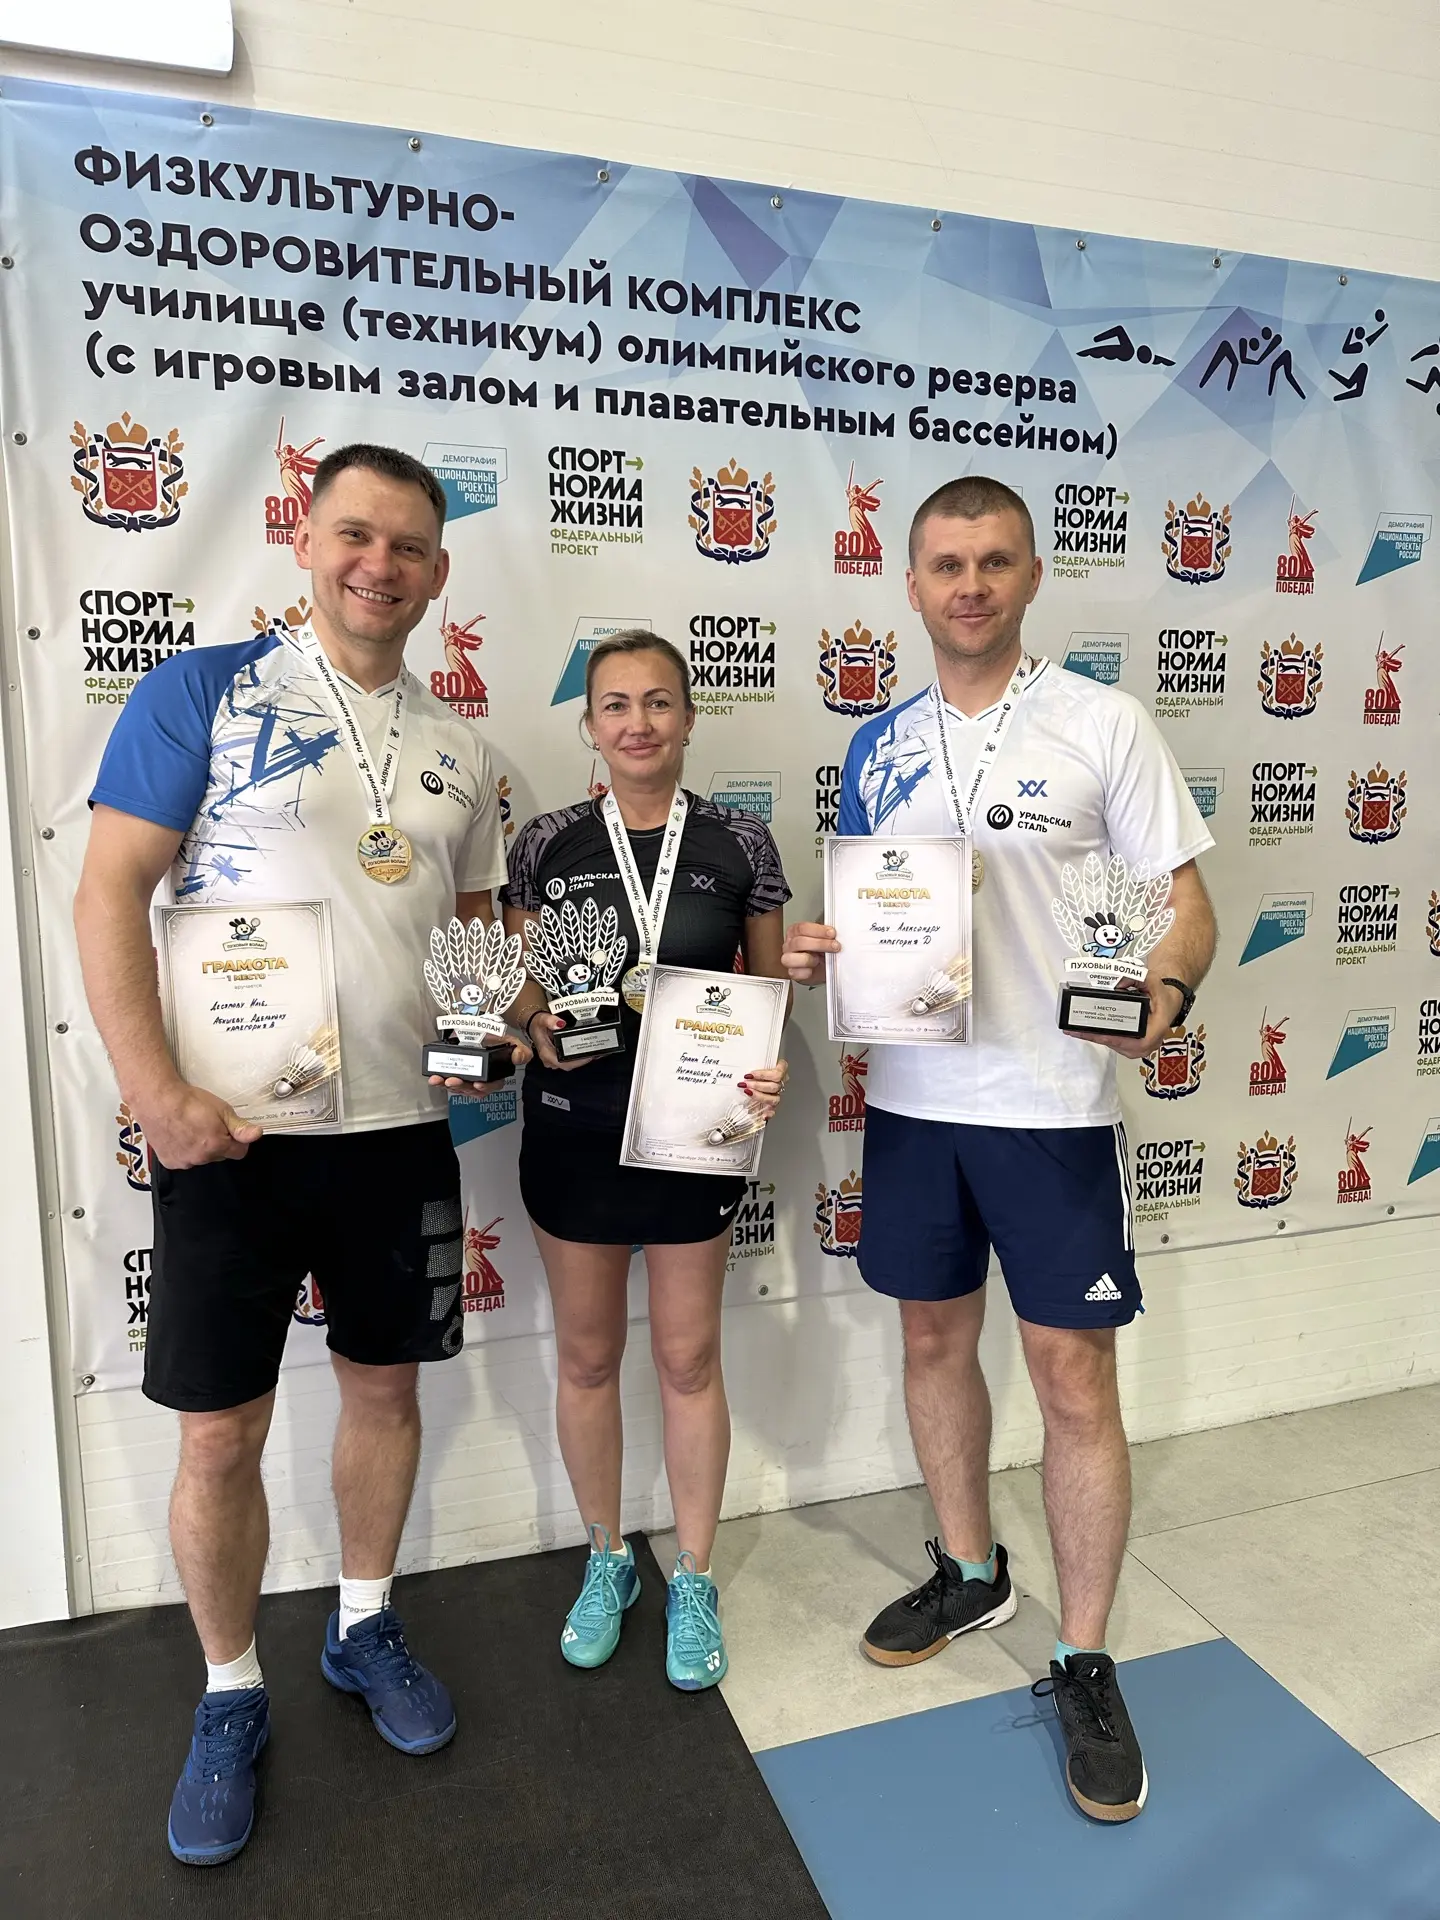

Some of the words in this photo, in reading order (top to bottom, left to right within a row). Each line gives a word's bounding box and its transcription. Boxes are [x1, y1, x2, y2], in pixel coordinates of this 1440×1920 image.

[74, 145, 515, 233] ФИЗКУЛЬТУРНО-
[80, 212, 612, 308] ОЗДОРОВИТЕЛЬНЫЙ
[627, 275, 861, 336] КОМПЛЕКС
[81, 279, 326, 335] училище
[341, 298, 603, 364] (техникум)
[616, 335, 916, 390] олимпийского
[926, 366, 1077, 406] резерва
[85, 330, 136, 378] (с
[154, 346, 381, 394] игровым
[397, 367, 538, 409] залом
[555, 383, 579, 411] и
[595, 385, 895, 438] плавательным
[908, 405, 1119, 460] бассейном)
[442, 454, 497, 465] ДЕМОГРАФИЯ
[548, 445, 625, 474] СПОРТ
[457, 481, 496, 494] ПРОЕКТЫ
[549, 472, 642, 501] НОРМА
[464, 492, 496, 504] РОССИИ
[1055, 484, 1116, 507] СПОРТ
[265, 496, 299, 523] 80
[550, 500, 643, 528] ЖИЗНИ
[1054, 507, 1128, 531] НОРМА
[1388, 521, 1425, 529] ДЕМОГРАФИЯ
[550, 528, 643, 544] ФЕДЕРАЛЬНЫЙ
[834, 531, 861, 556] 80
[1054, 530, 1126, 554] ЖИЗНИ
[1378, 532, 1423, 542] НАЦИОНАЛЬНЫЕ
[551, 543, 599, 556] ПРОЕКТ
[1395, 542, 1421, 550] ПРОЕКТЫ
[1053, 555, 1125, 568] ФЕДЕРАЛЬНЫЙ
[1398, 551, 1420, 559] РОССИИ
[834, 561, 883, 577] ПОБЕДА!
[1053, 568, 1089, 578] ПРОЕКТ
[1277, 555, 1297, 577] 80
[1276, 581, 1314, 595] ПОБЕДА!
[80, 590, 173, 617] СПОРТ
[81, 618, 195, 646] НОРМА
[689, 615, 760, 639] СПОРТ
[1082, 641, 1122, 649] ДЕМОГРАФИЯ
[1158, 629, 1215, 650] СПОРТ
[84, 647, 182, 672] ЖИЗН
[690, 641, 775, 664] НОРМА
[1069, 653, 1119, 663] НАЦИОНАЛЬНЫЕ
[315, 655, 333, 685] РАЗРЯД
[1090, 663, 1119, 672] ПРОЕКТЫ
[1157, 651, 1226, 672] НОРМА
[431, 671, 462, 697] 80
[691, 665, 775, 688] ЖИЗНИ
[1095, 671, 1118, 681] РОССИИ
[1156, 673, 1225, 693] ЖИЗНИ
[86, 693, 129, 704] ПРОЕ
[328, 682, 350, 718] МУЖСКОЙ
[690, 691, 775, 703] ФЕДЕРАЛЬНЫЙ
[1155, 696, 1224, 707] ФЕДЕРАЛЬНЫЙ
[1365, 689, 1385, 710] 80
[1155, 708, 1190, 718] ПРОЕКТ
[1363, 712, 1400, 726] ПОБЕДА!
[346, 719, 364, 753] ПАРНЫЙ
[941, 739, 953, 780] ОДИНОЧНЫЙ
[381, 753, 393, 787] ОРЕНБУРГ
[1252, 762, 1306, 781] СПОРТ
[366, 774, 383, 818] КАТЕГОРИЯ
[967, 768, 984, 807] ОРЕНБУРГ
[1251, 783, 1316, 802] НОРМА
[714, 793, 771, 803] НАЦИОНАЛЬНЫЕ
[738, 803, 771, 812] ПРОЕКТЫ
[1250, 803, 1315, 822] ЖИЗНИ
[1017, 821, 1048, 833] СТАЛЬ
[1019, 810, 1072, 828] УРАЛЬСКАЯ
[613, 821, 623, 845] РАЗРЯД
[1249, 823, 1313, 836] ФЕДЕРАЛЬНЫЙ
[1249, 837, 1282, 846] ПРОЕКТ
[619, 845, 633, 876] ЖЕНСКИЙ
[568, 881, 595, 892] СТАЛЬ
[569, 873, 620, 884] УРАЛЬСКАЯ
[627, 875, 640, 901] ПАРНЫЙ
[858, 888, 931, 899] ГРАМОТА
[1339, 884, 1389, 903] СПОРТ
[652, 889, 663, 923] ОРЕНБУРГ
[1338, 903, 1399, 923] НОРМА
[1261, 910, 1305, 920] НАЦИОНАЛЬНЫЕ
[1279, 919, 1304, 928] ПРОЕКТЫ
[640, 917, 651, 956] КАТЕГОРИЯ
[1283, 927, 1304, 935] РОССИИ
[1337, 923, 1397, 943] ЖИЗНИ
[1336, 942, 1396, 955] ФЕДЕРАЛЬНЫЙ
[202, 957, 289, 974] ГРАМОТА
[1071, 961, 1112, 970] ПУХОВЫЙ
[1114, 966, 1142, 977] ВОЛАН
[1336, 956, 1366, 966] ПРОЕКТ
[234, 973, 266, 981] МЕСТО
[555, 997, 589, 1010] ПУХОВЫЙ
[477, 1022, 501, 1033] ВОЛАН
[675, 1018, 745, 1036] ГРАМОТА
[698, 1034, 725, 1042] МЕСТО
[1250, 1061, 1270, 1081] 80
[1417, 1067, 1440, 1076] ПРОЕК
[1249, 1083, 1286, 1096] ПОБЕДА!
[479, 1102, 516, 1112] ПРОЕКТЫ
[829, 1095, 854, 1116] 80
[486, 1111, 516, 1121] РОССИИ
[829, 1119, 865, 1133] ПОБЕД
[1136, 1139, 1193, 1160] СПОРТ
[1136, 1158, 1204, 1181] НОРМА
[1338, 1169, 1355, 1190] 80
[1136, 1177, 1202, 1200] ЖИЗНИ
[1337, 1189, 1371, 1204] ПОБЕДА!
[1135, 1196, 1201, 1212] ФЕДЕРАЛЬНЫЙ
[1135, 1211, 1170, 1223] ПРОЕКТ
[730, 1222, 775, 1246] ЗНИ
[729, 1244, 775, 1260] АЛЬНЫЙ
[1084, 1291, 1122, 1301] adidas
